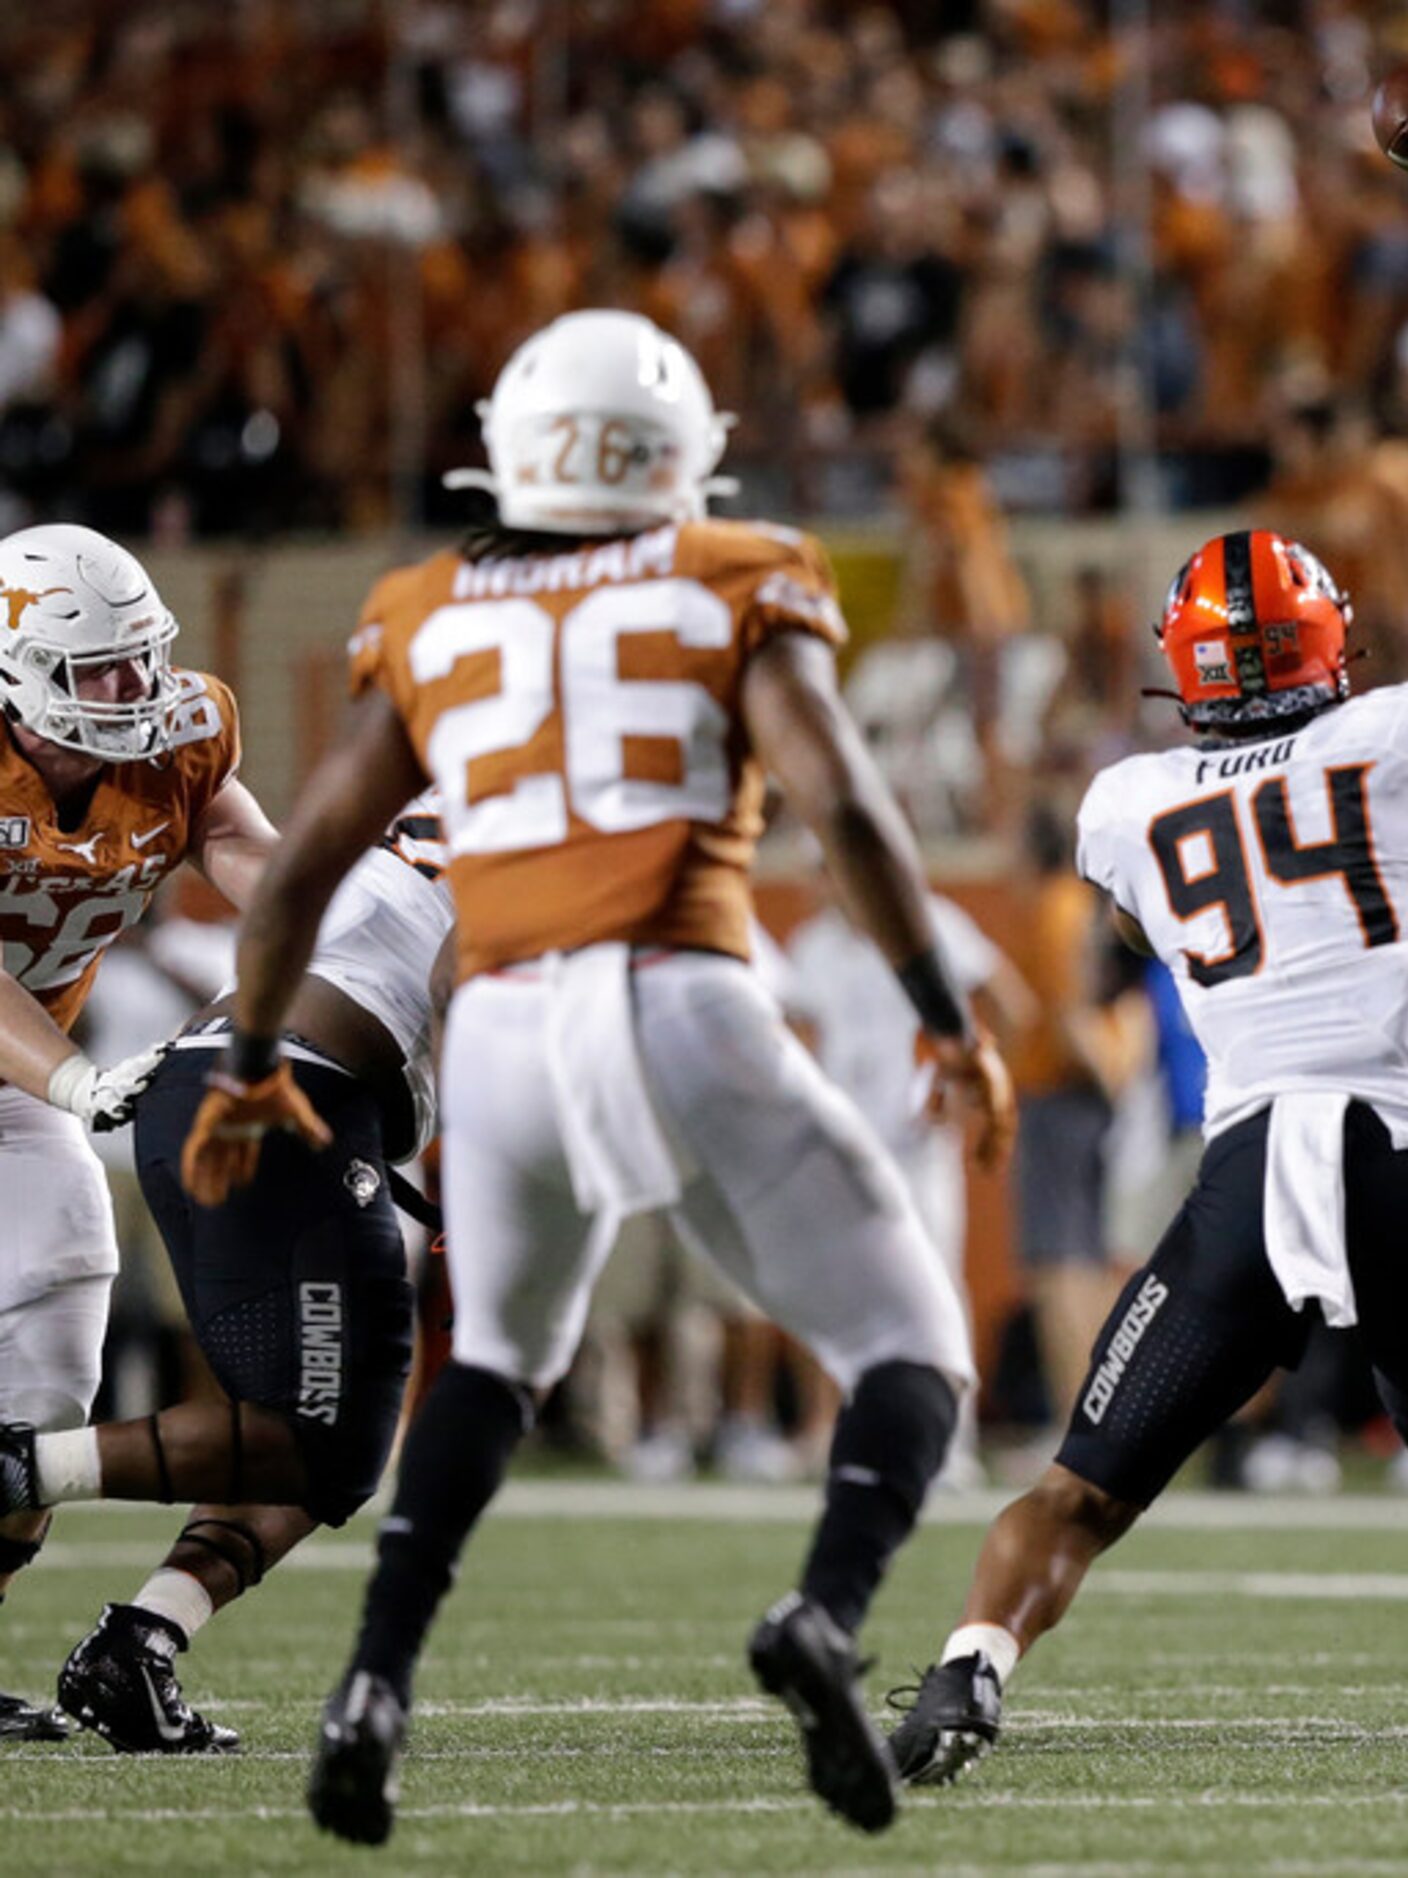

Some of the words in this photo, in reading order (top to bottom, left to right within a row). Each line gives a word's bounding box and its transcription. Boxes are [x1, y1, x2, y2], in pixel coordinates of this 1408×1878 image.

[549, 414, 633, 487] 26
[410, 579, 732, 853] 26
[1146, 760, 1399, 988] 94
[296, 1281, 343, 1425] COWBOYS
[1082, 1273, 1170, 1426] COWBOYS
